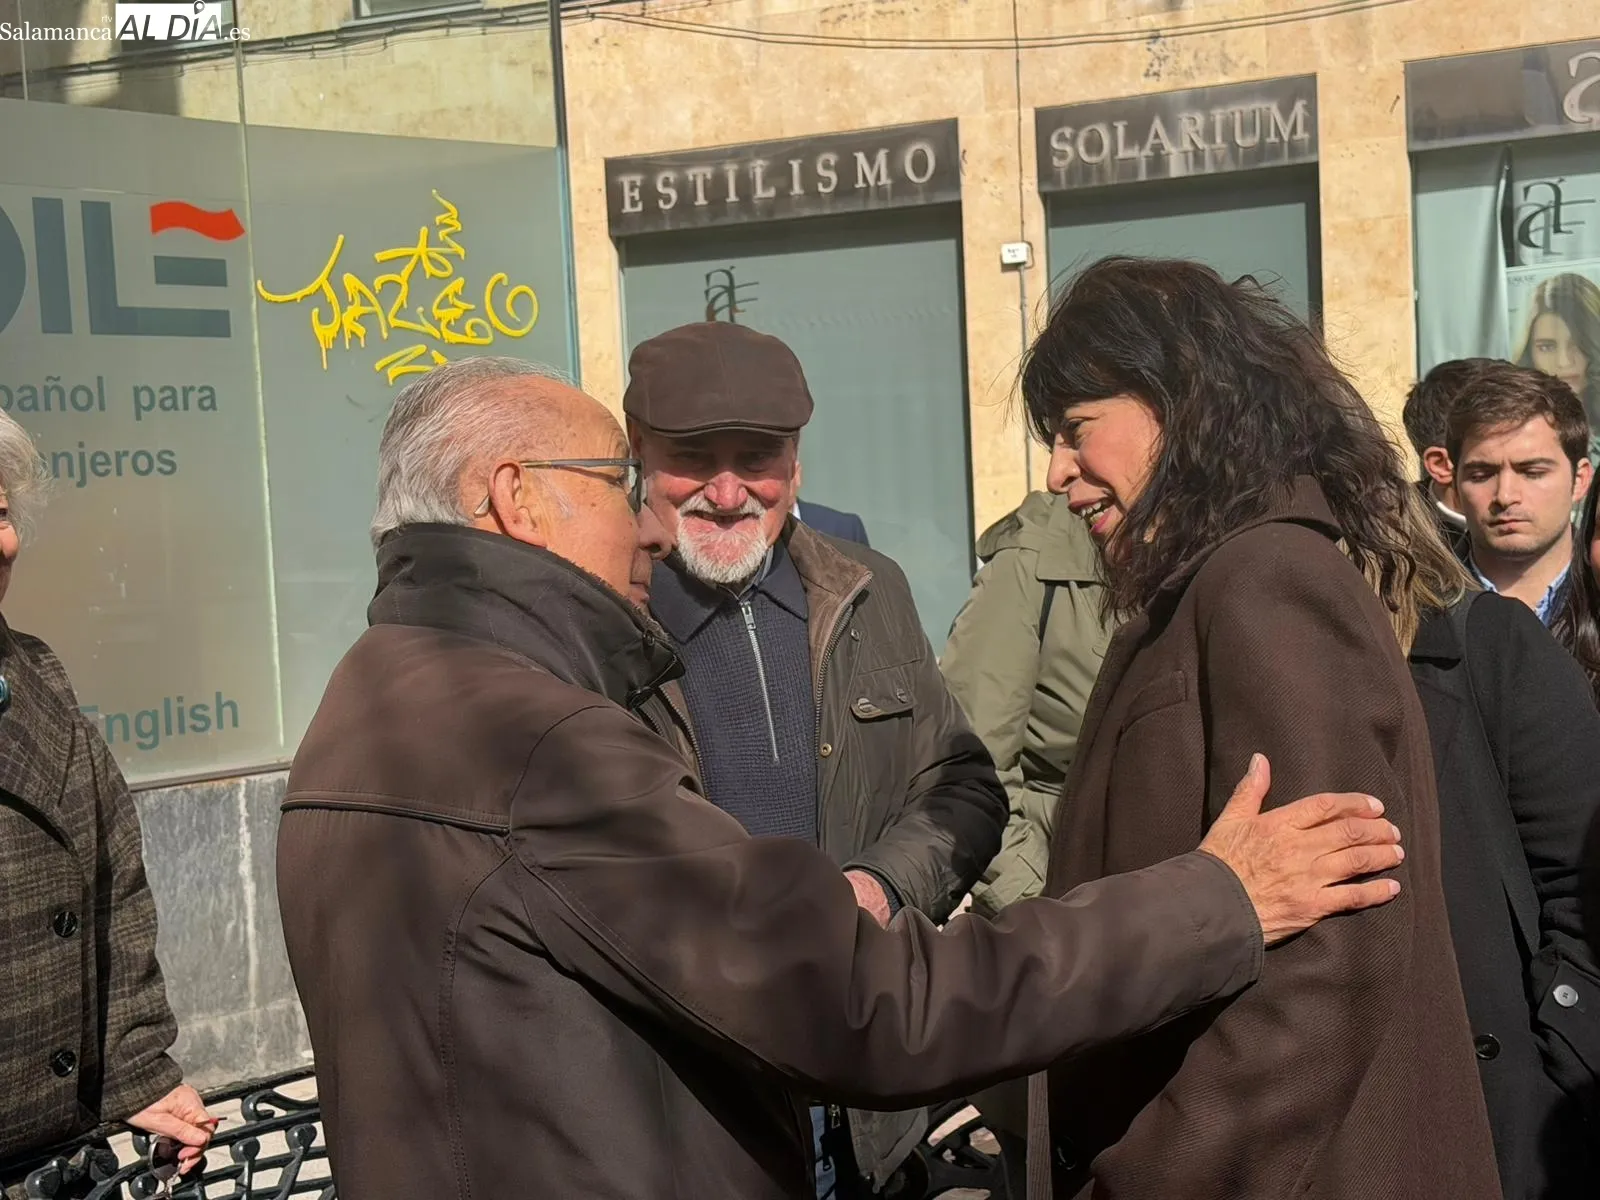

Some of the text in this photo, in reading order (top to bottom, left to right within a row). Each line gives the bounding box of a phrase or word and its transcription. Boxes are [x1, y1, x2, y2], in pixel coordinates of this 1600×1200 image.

[1050, 98, 1310, 171] SOLARIUM
[618, 141, 937, 214] ESTILISMO
[133, 383, 218, 421] para
[39, 440, 178, 489] njeros
[80, 690, 240, 752] nglish
